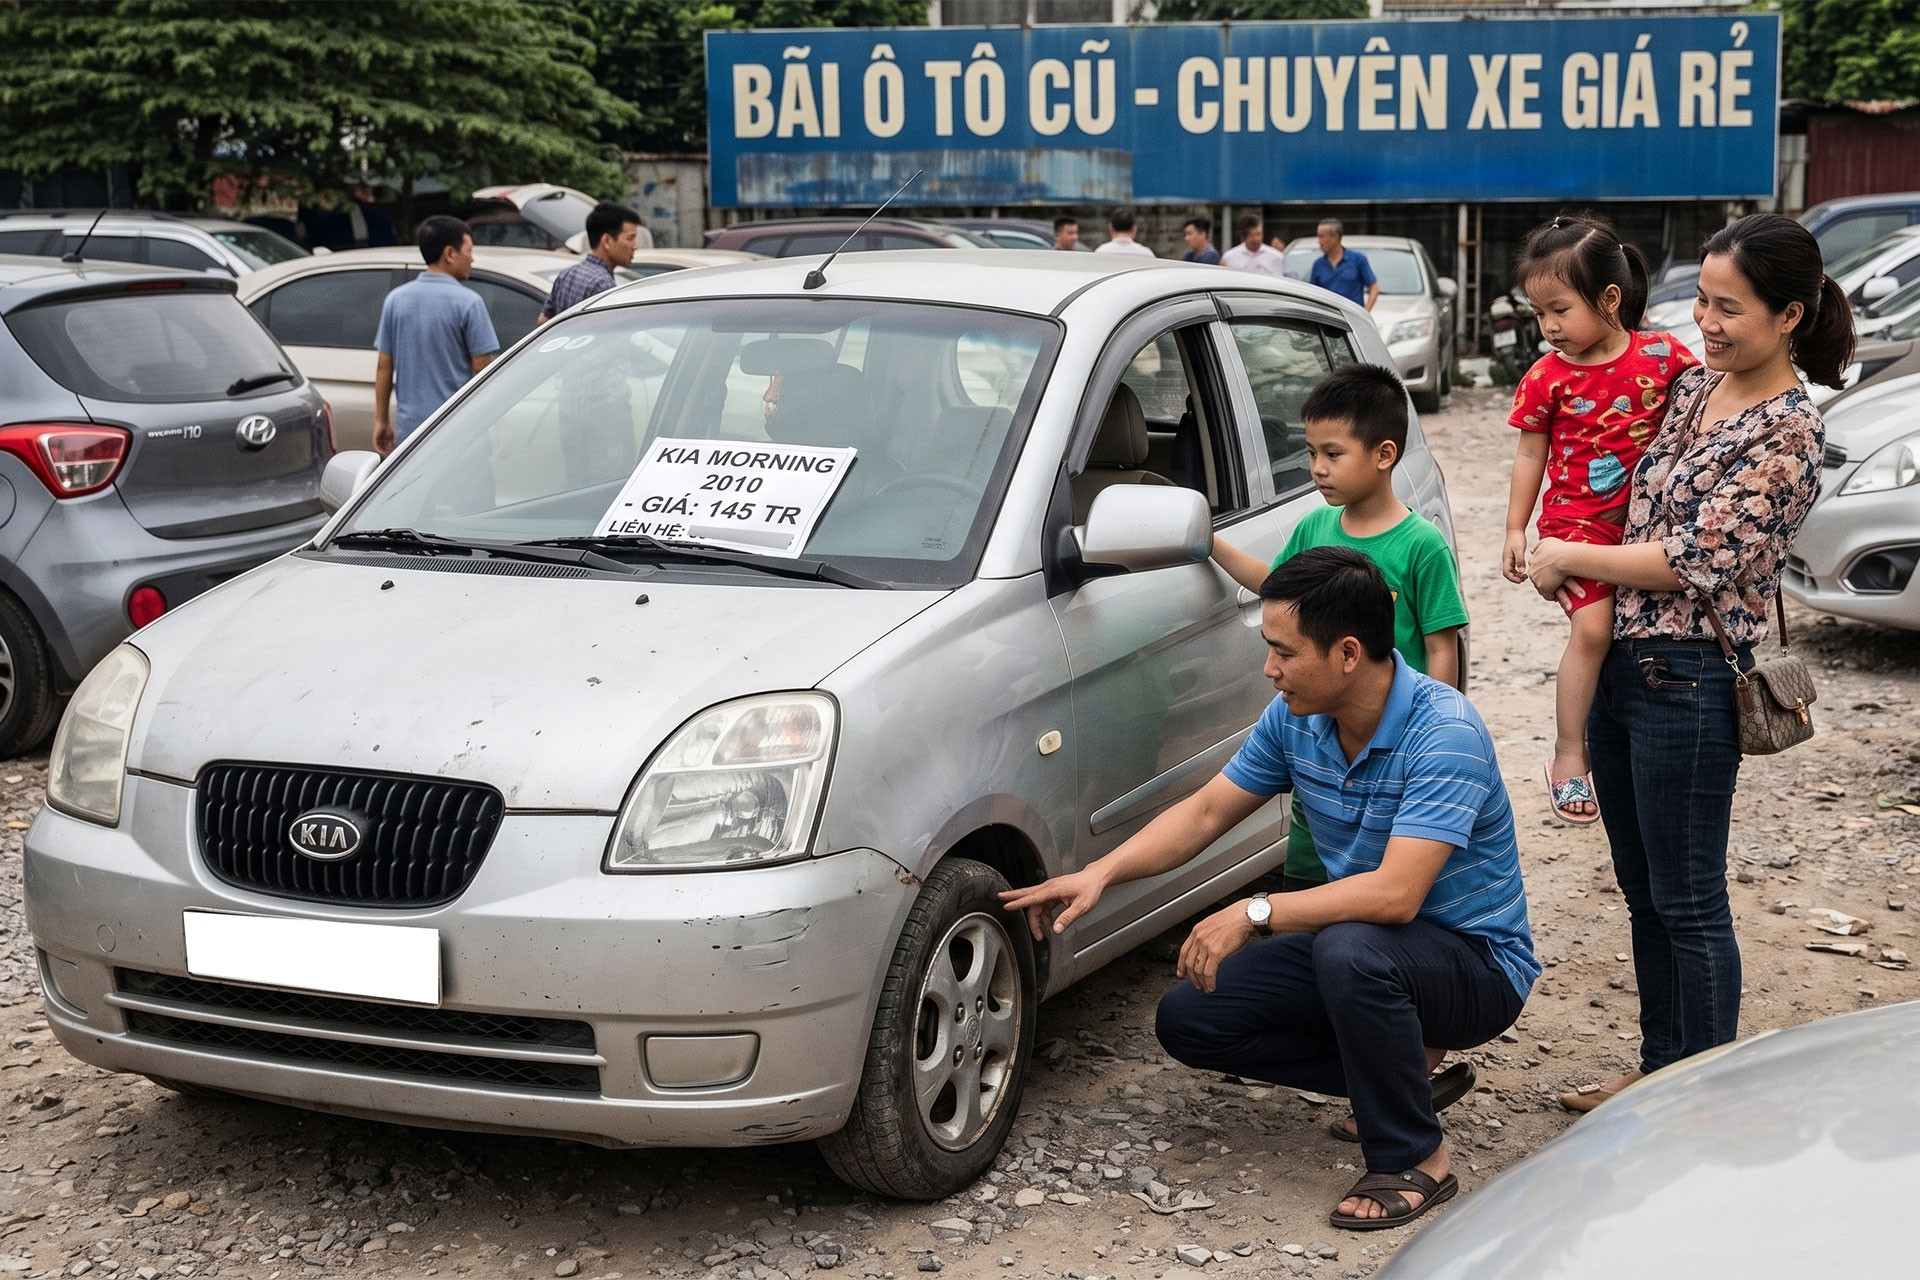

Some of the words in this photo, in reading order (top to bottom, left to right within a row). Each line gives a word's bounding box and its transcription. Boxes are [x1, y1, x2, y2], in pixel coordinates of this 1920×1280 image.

[732, 45, 841, 139] BÃI
[863, 43, 905, 138] Ô
[924, 42, 1006, 138] TÔ
[1028, 39, 1116, 136] CŨ
[1177, 36, 1448, 135] CHUYÊN
[1467, 54, 1542, 131] XE
[1561, 33, 1660, 130] GIÁ
[1678, 20, 1754, 128] RẺ
[656, 447, 700, 465] KIA
[706, 450, 836, 473] MORNING
[699, 474, 763, 493] 2010
[641, 493, 699, 516] GIÁ:
[709, 500, 756, 520] 145
[764, 504, 801, 525] TR
[301, 824, 347, 848] KIA
